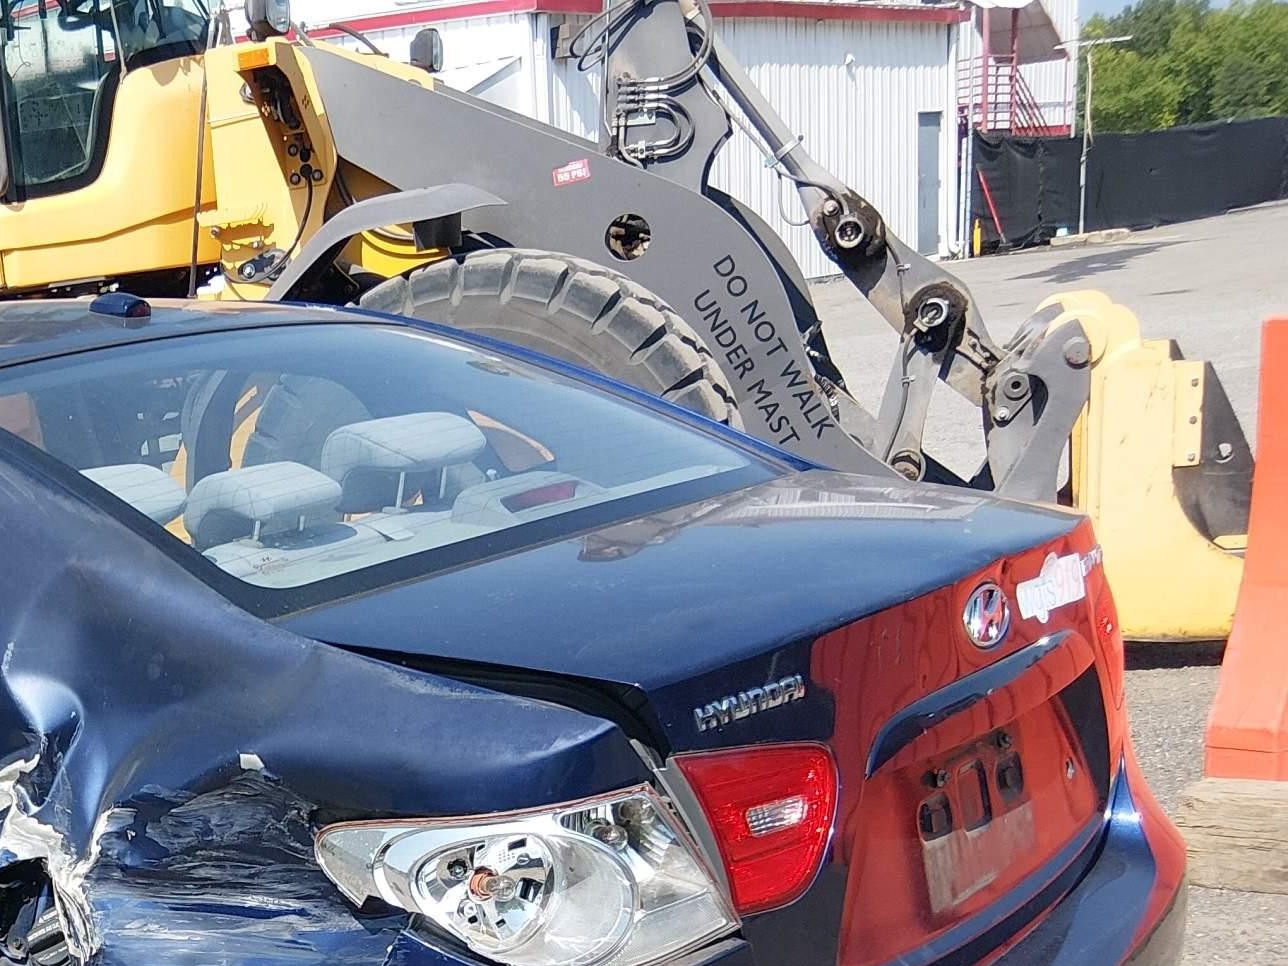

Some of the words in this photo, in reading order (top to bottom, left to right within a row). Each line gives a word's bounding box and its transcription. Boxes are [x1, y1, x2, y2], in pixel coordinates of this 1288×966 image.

[694, 289, 755, 380] UNDER
[746, 379, 801, 445] MAST
[713, 254, 748, 297] DO
[740, 299, 788, 357] NOT
[779, 359, 835, 439] WALK
[693, 674, 806, 733] HYUNDAI
